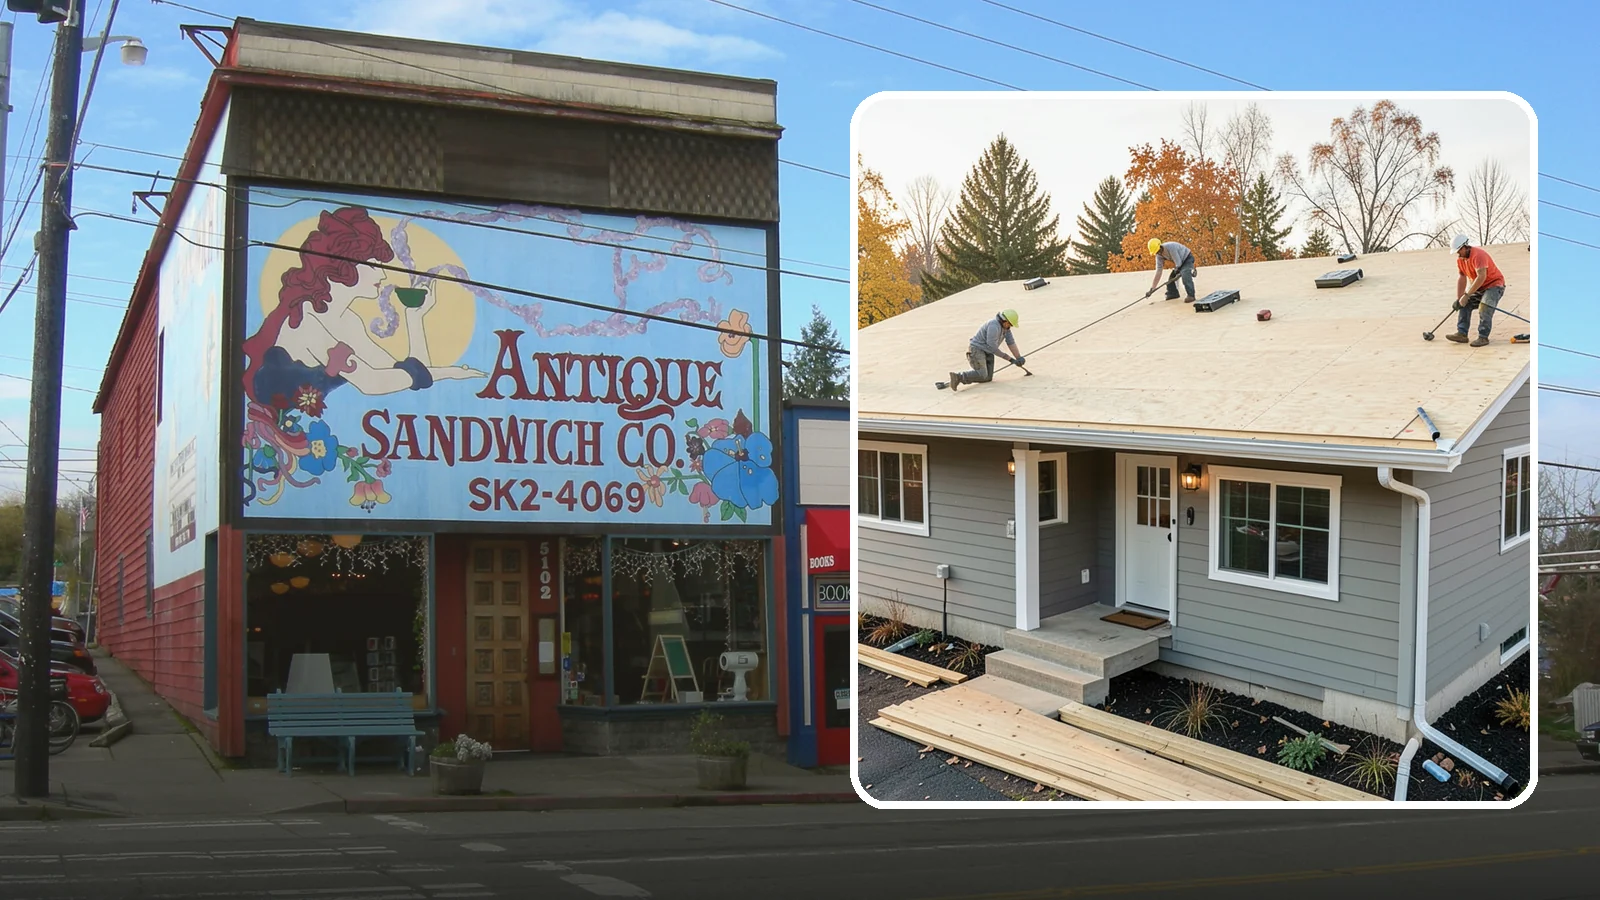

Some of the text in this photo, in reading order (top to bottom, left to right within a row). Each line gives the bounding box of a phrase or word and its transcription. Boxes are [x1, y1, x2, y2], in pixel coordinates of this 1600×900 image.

[475, 328, 724, 421] ANTIQUE
[361, 408, 685, 469] SANDWICH CO.
[467, 476, 646, 513] SK2-4069
[540, 541, 551, 600] 5102
[809, 555, 835, 569] BOOKS
